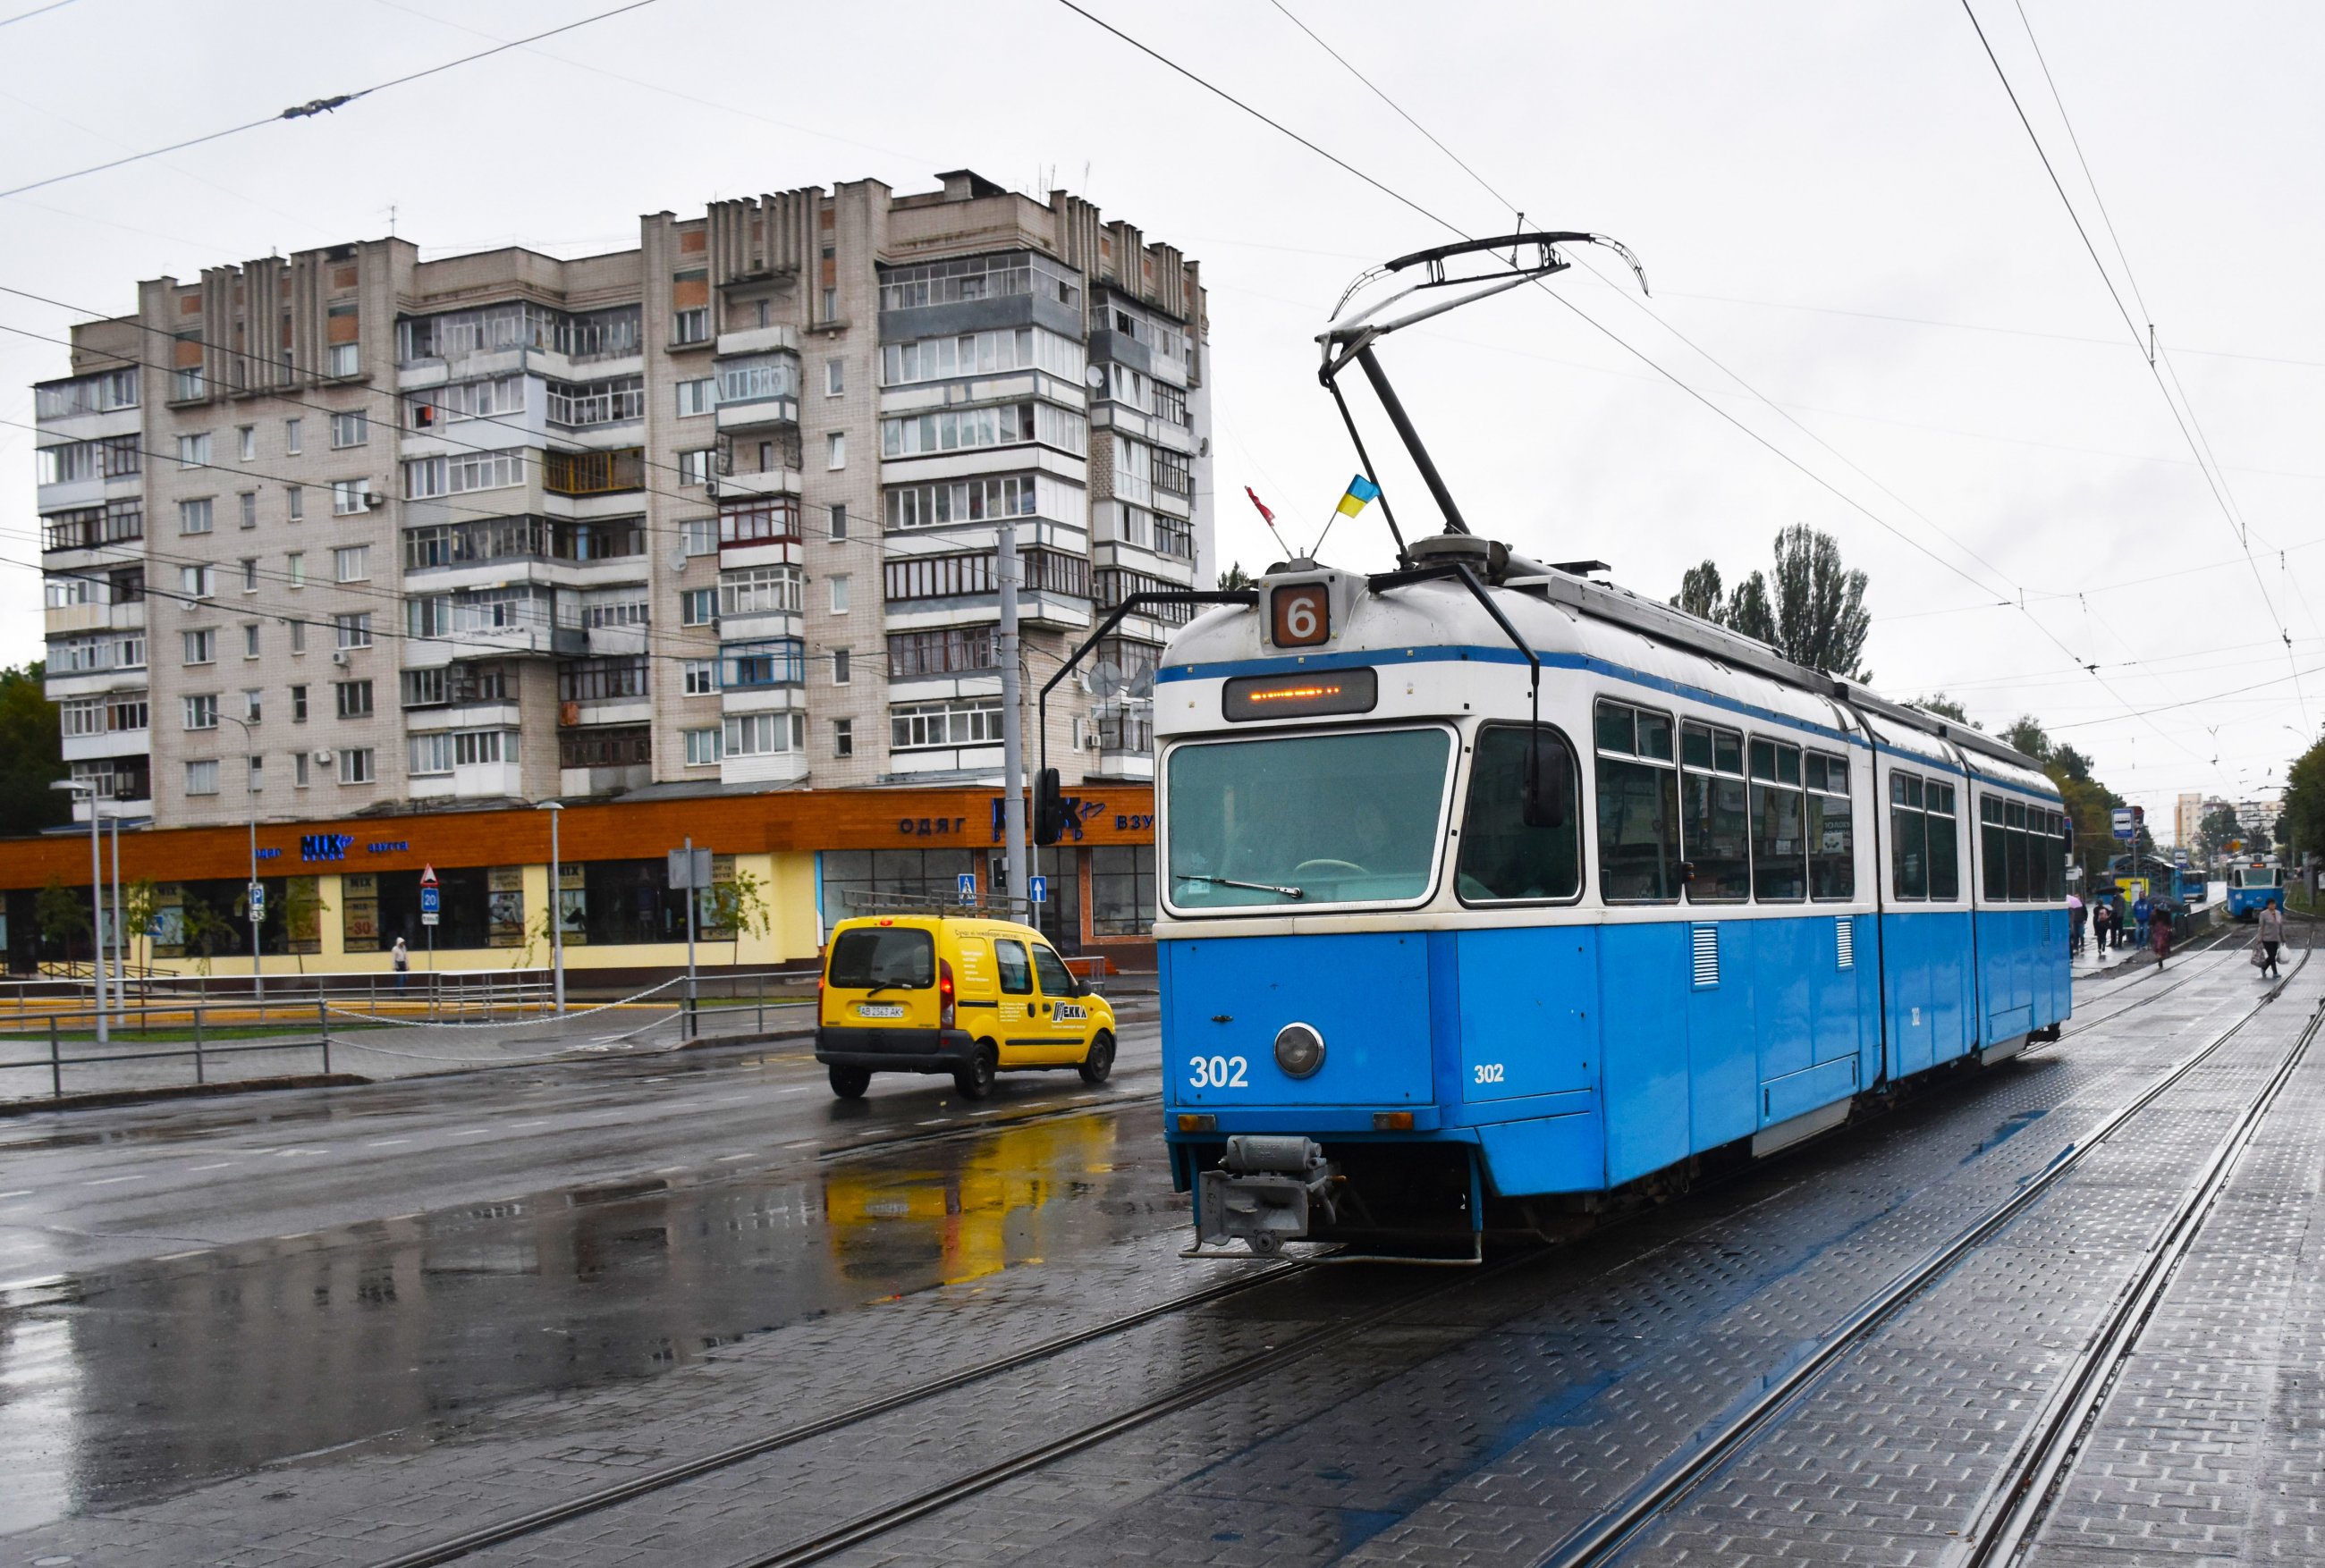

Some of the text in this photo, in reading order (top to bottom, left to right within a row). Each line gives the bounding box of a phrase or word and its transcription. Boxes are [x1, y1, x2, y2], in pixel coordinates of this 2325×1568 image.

[1287, 597, 1317, 638] 6
[899, 817, 966, 836] ОДЯГ
[253, 889, 261, 903] P
[425, 894, 436, 906] 20
[1189, 1056, 1248, 1088] 302
[1474, 1063, 1504, 1084] 302
